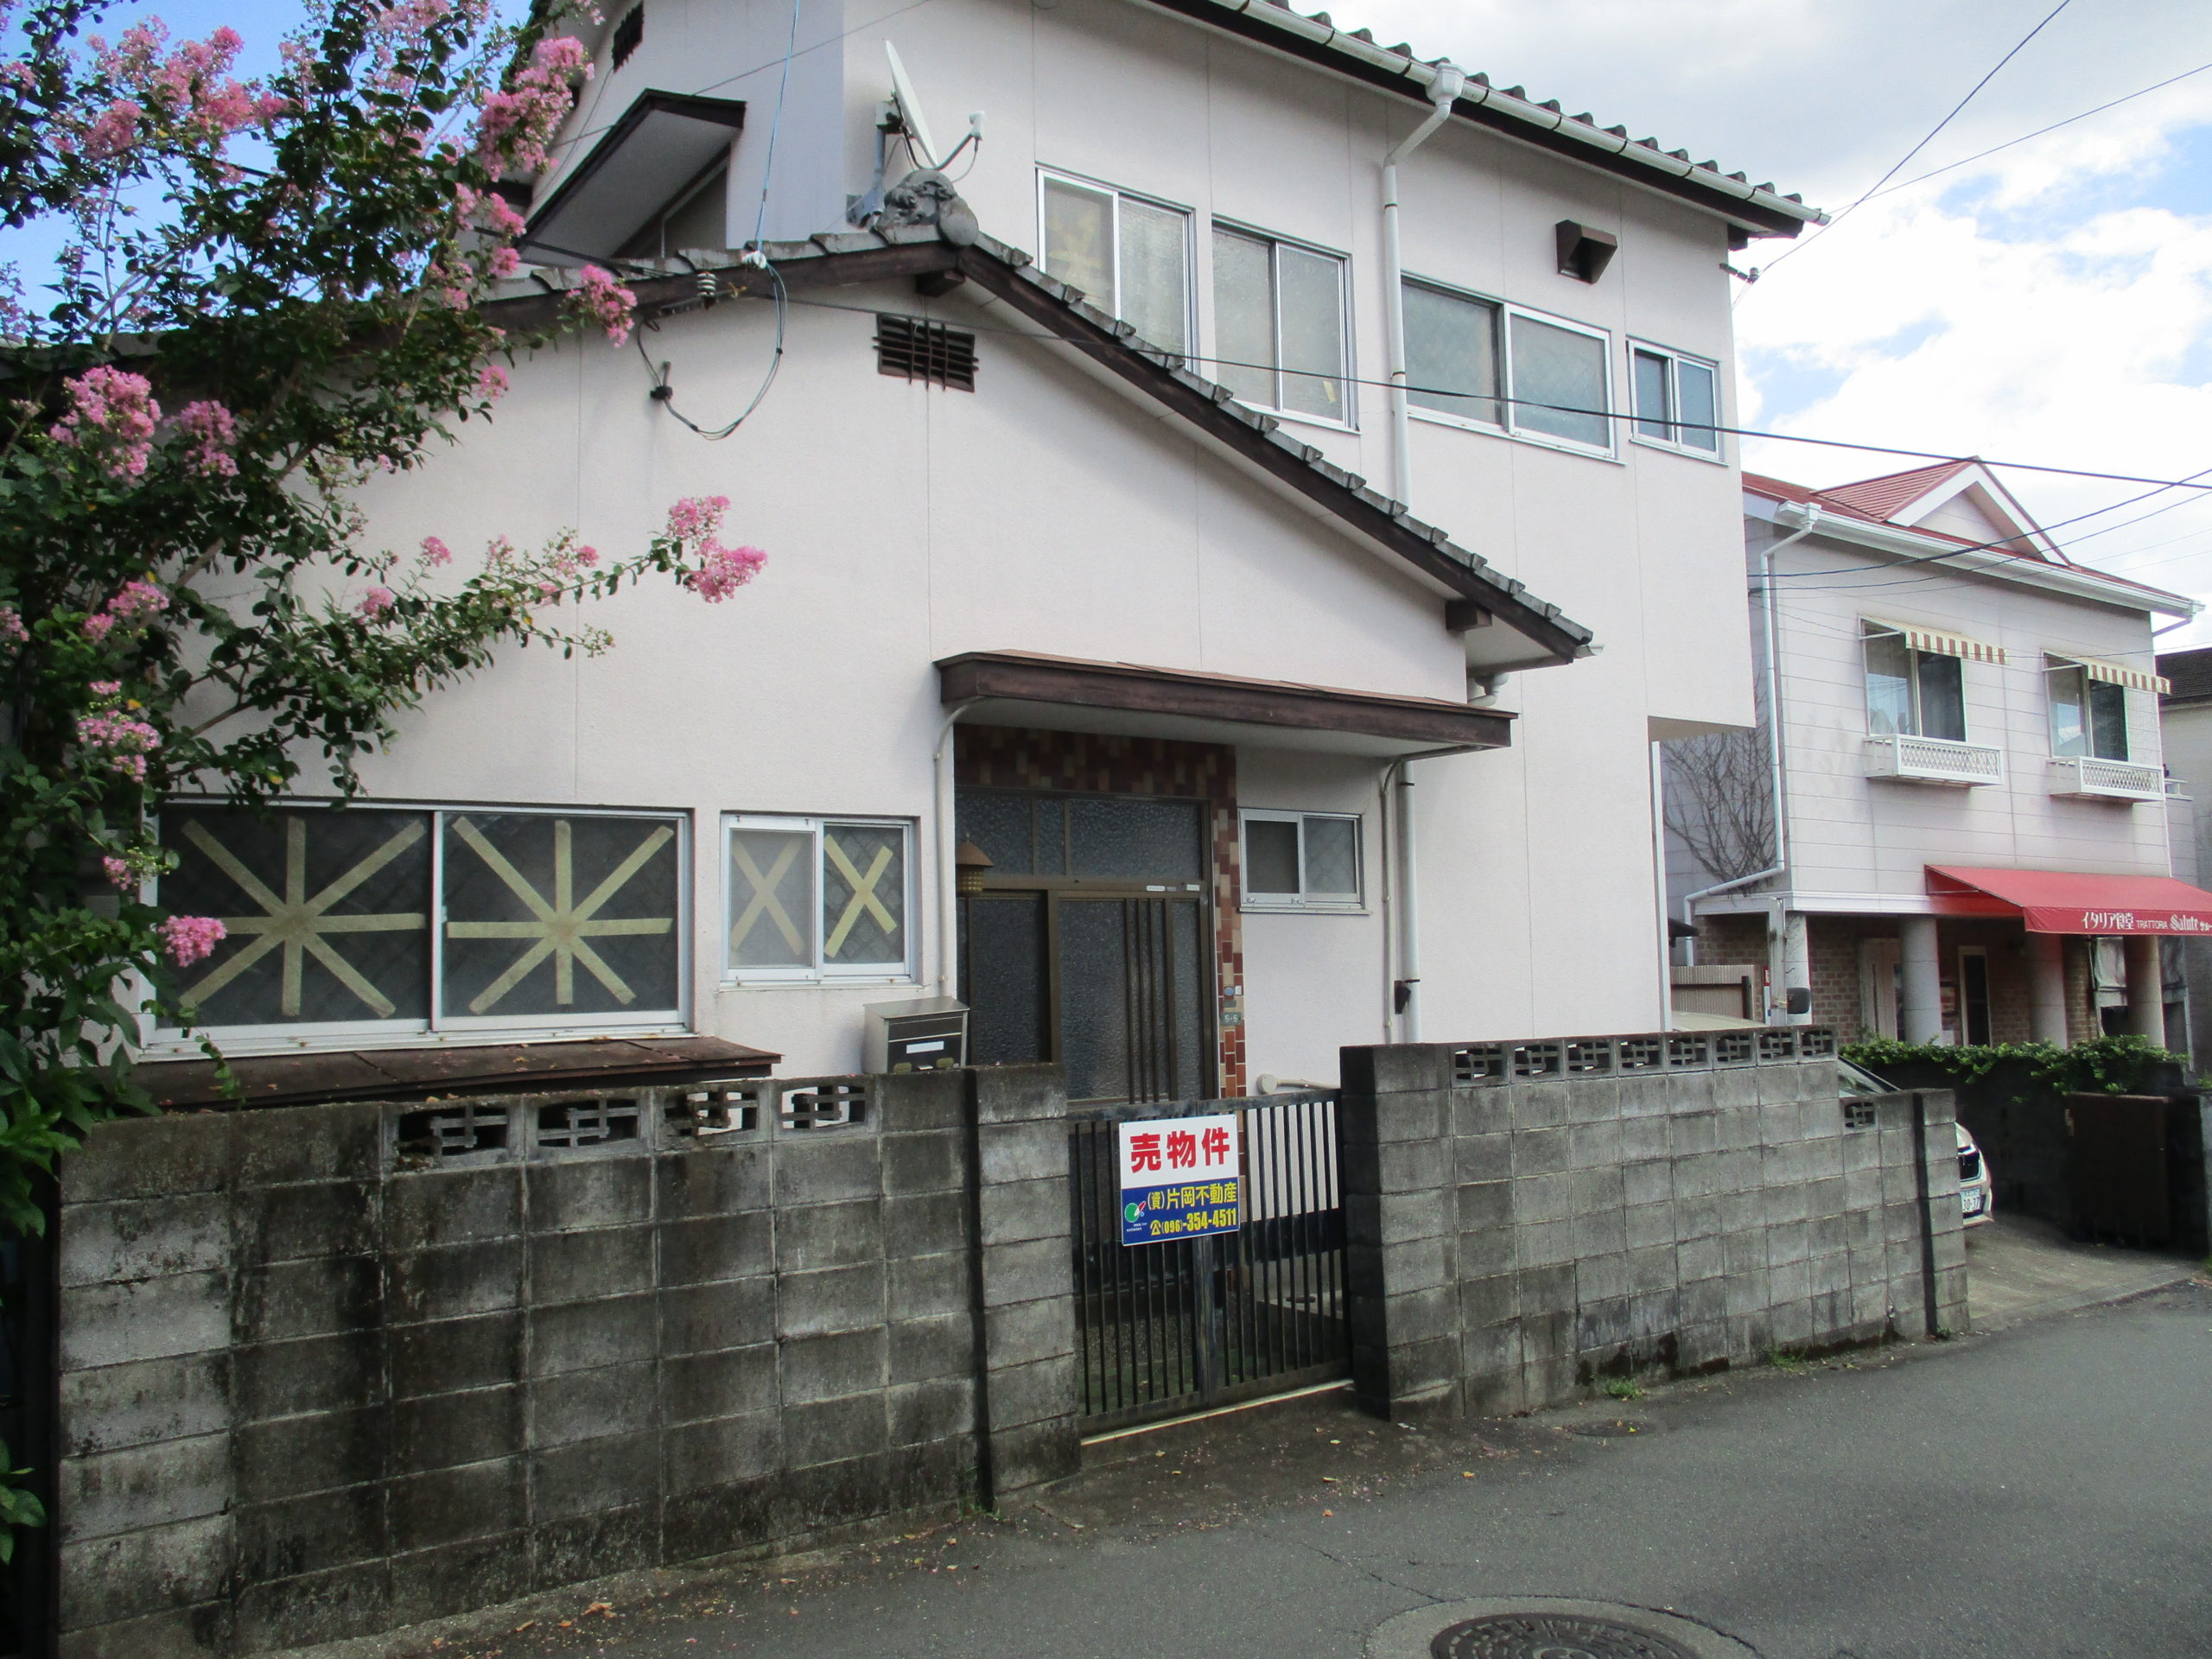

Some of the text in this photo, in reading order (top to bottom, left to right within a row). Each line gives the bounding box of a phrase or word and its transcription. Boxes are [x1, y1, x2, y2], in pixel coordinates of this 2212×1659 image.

[2082, 912, 2134, 930] イタリア食堂
[1130, 1127, 1230, 1173] 売物件
